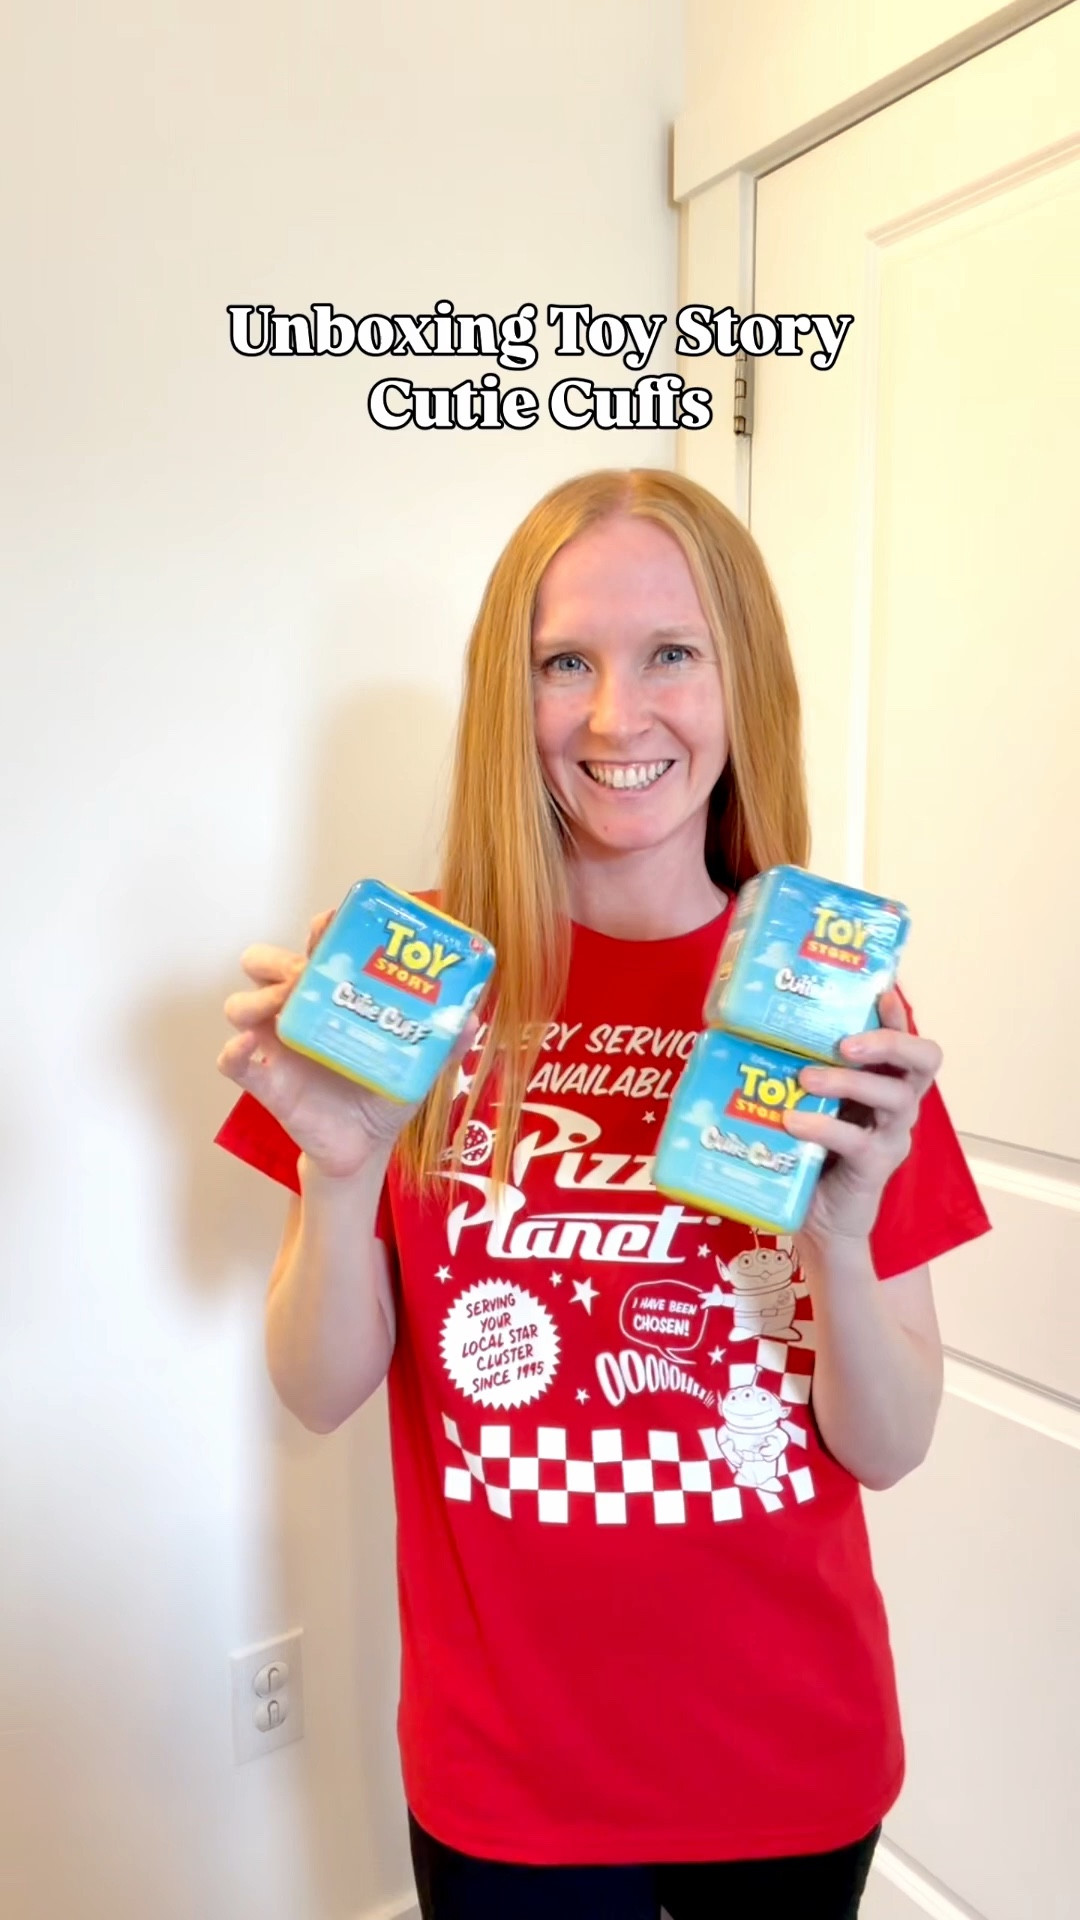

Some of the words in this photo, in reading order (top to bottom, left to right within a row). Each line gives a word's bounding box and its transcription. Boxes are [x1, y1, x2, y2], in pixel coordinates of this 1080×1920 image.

[814, 906, 872, 950] TOY
[385, 919, 464, 980] TOY
[805, 940, 862, 966] STORY
[373, 956, 436, 996] STORY
[774, 966, 824, 1000] Cuti
[331, 979, 380, 1022] Cutie
[377, 1005, 433, 1045] Cuff
[585, 1023, 698, 1060] SERVIC
[526, 1062, 683, 1101] AVAILABL
[740, 1063, 806, 1110] TOY
[734, 1097, 783, 1123] STOR
[488, 1101, 657, 1191] Pizz
[427, 1170, 704, 1264] Planet
[466, 1292, 516, 1319] SERVING
[480, 1312, 512, 1334] YOUR
[631, 1297, 639, 1309] I
[639, 1299, 667, 1311] HAVE
[669, 1301, 698, 1316] BEEN
[462, 1332, 504, 1358] LOCAL
[508, 1323, 538, 1344] STAR
[633, 1314, 690, 1337] CHOSEN!
[476, 1343, 533, 1372] CLUSTER
[472, 1369, 511, 1394] SINCE
[517, 1361, 545, 1380] 1995
